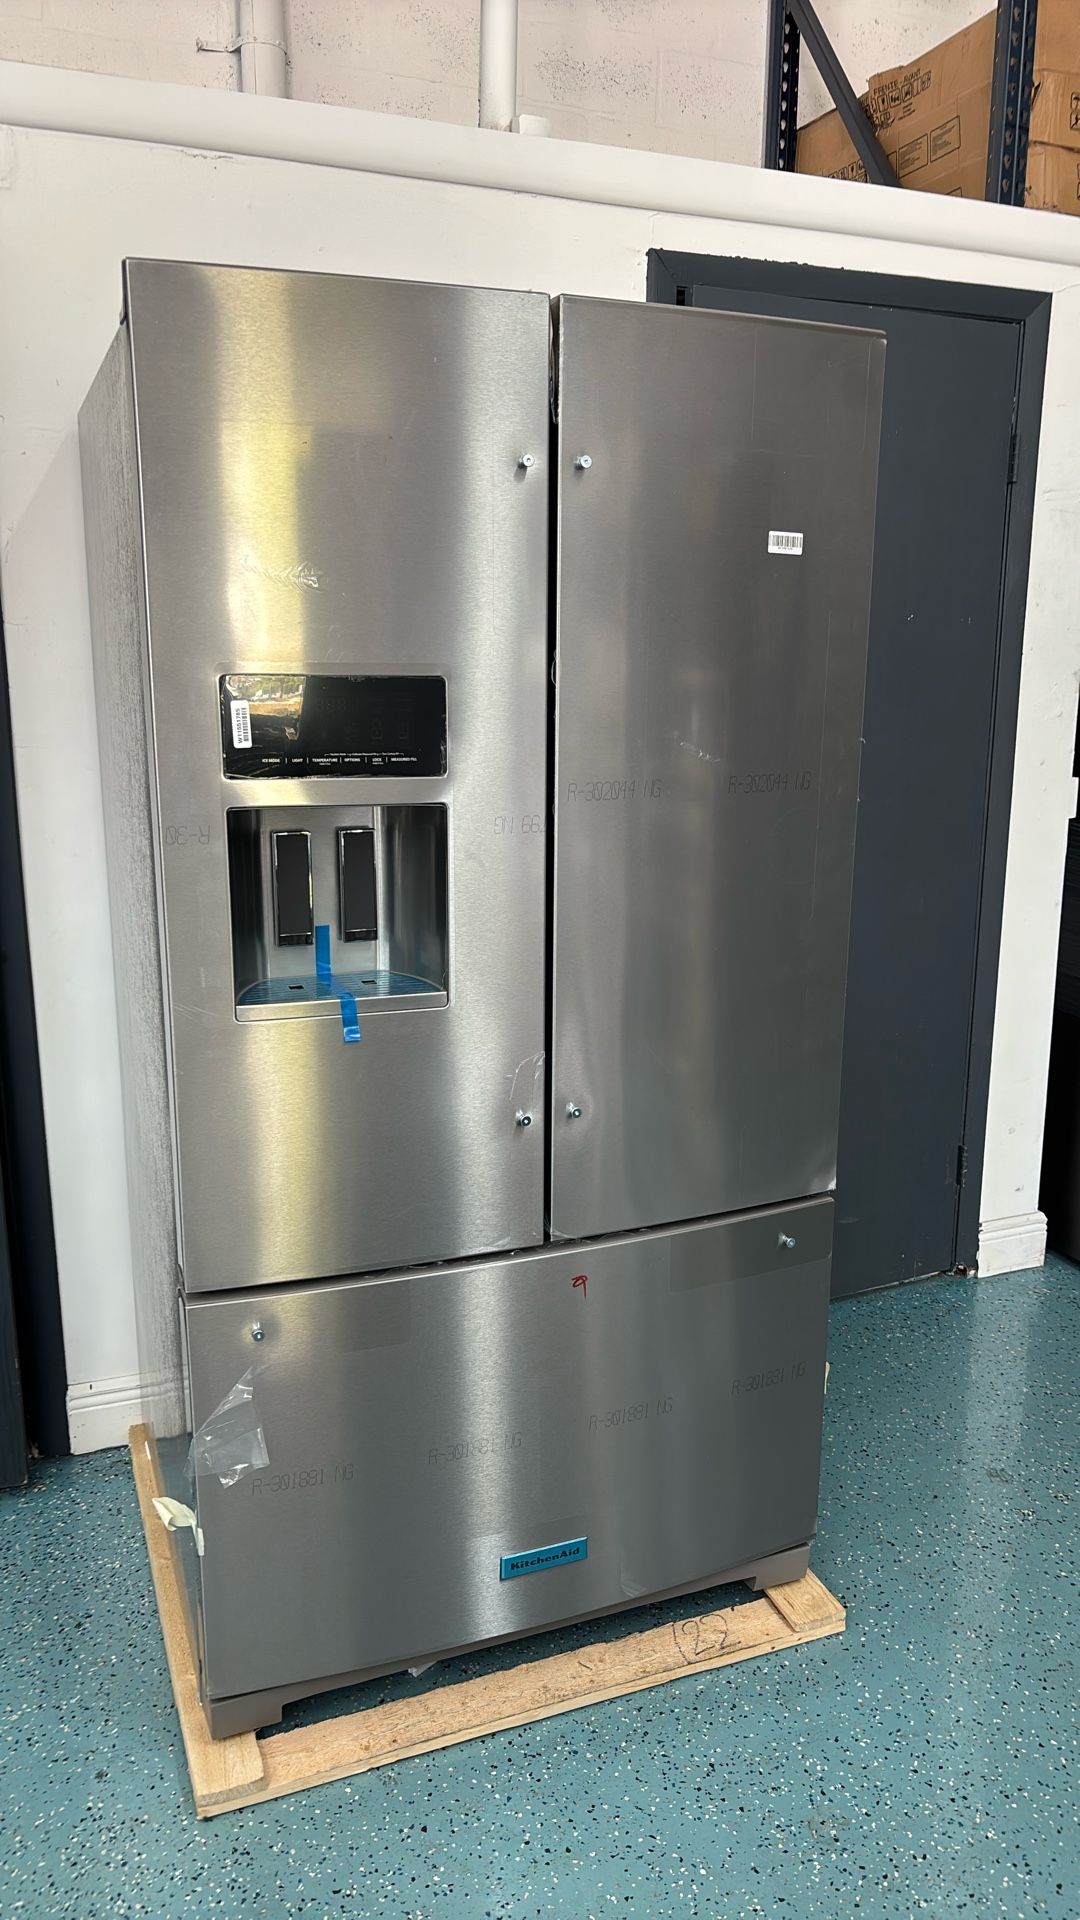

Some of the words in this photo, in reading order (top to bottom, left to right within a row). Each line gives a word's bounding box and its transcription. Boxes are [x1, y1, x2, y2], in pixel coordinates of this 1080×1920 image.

[643, 779, 662, 799] NG
[794, 771, 812, 791] NG
[791, 1361, 807, 1380] NG
[656, 1397, 673, 1416] NG
[334, 1464, 354, 1482] NG
[510, 1546, 580, 1572] KitchenAid
